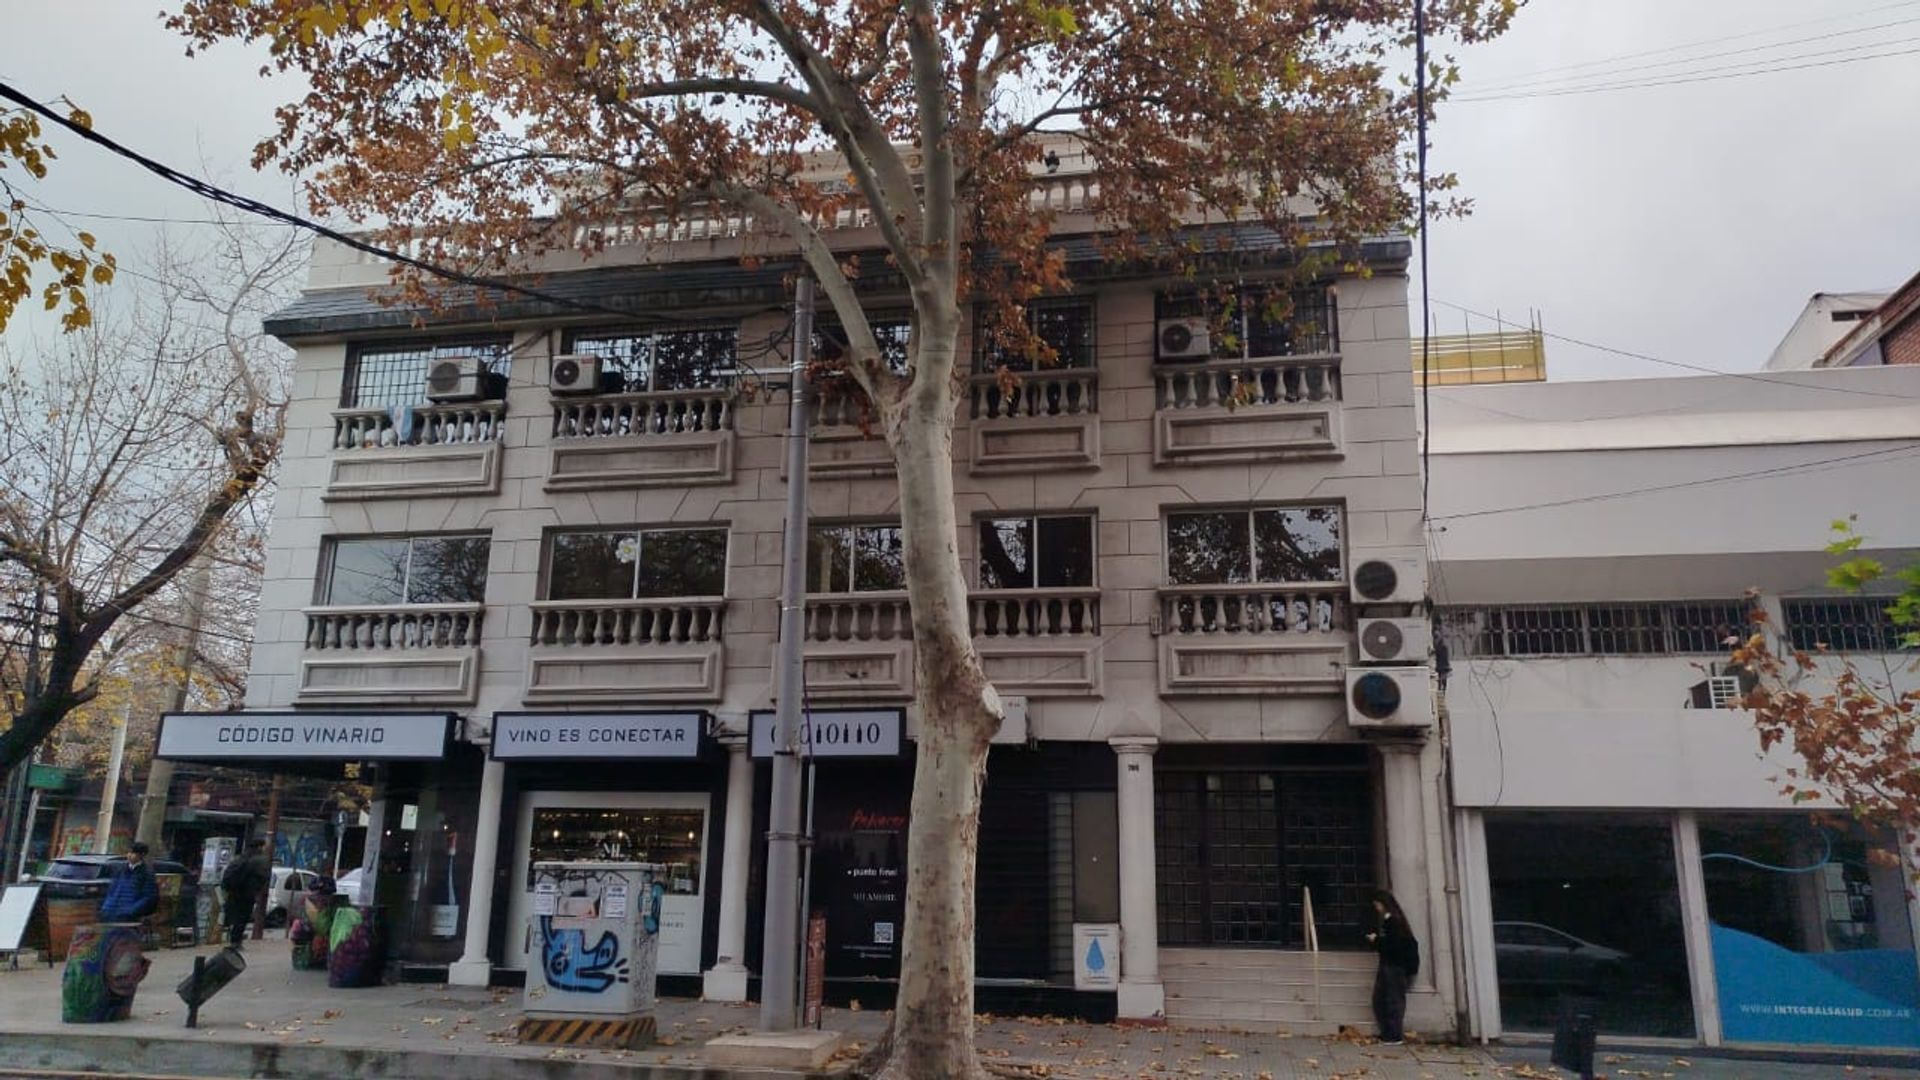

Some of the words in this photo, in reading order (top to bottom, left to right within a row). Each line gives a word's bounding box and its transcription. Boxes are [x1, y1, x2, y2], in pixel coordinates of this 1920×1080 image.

[218, 724, 295, 743] CÓDIGO
[302, 727, 385, 743] VINARIO
[508, 728, 551, 743] VINO
[558, 728, 581, 743] ES
[588, 728, 686, 743] CONECTAR
